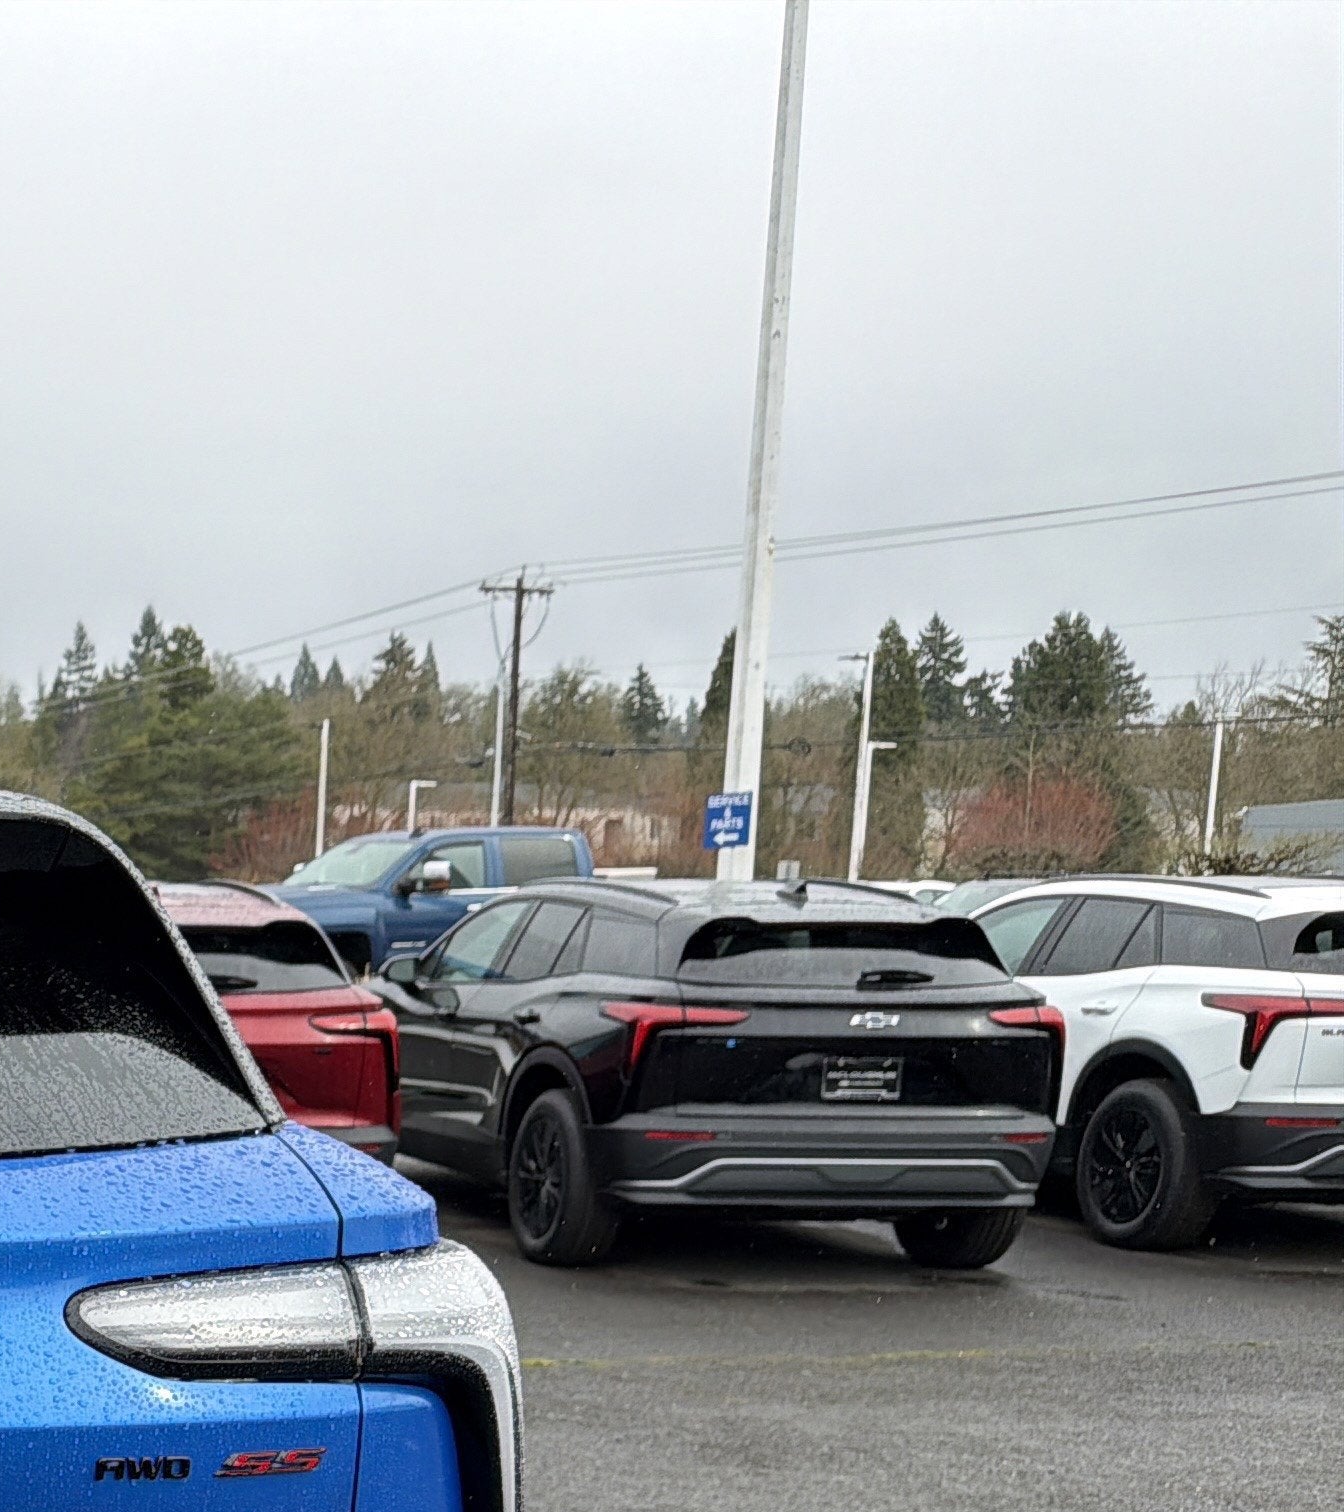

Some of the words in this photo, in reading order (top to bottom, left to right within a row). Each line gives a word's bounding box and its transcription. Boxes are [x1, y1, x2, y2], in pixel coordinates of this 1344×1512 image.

[707, 794, 749, 808] SERVICE
[710, 816, 744, 831] PARTS
[94, 1455, 192, 1482] AWD
[212, 1446, 328, 1479] SS
